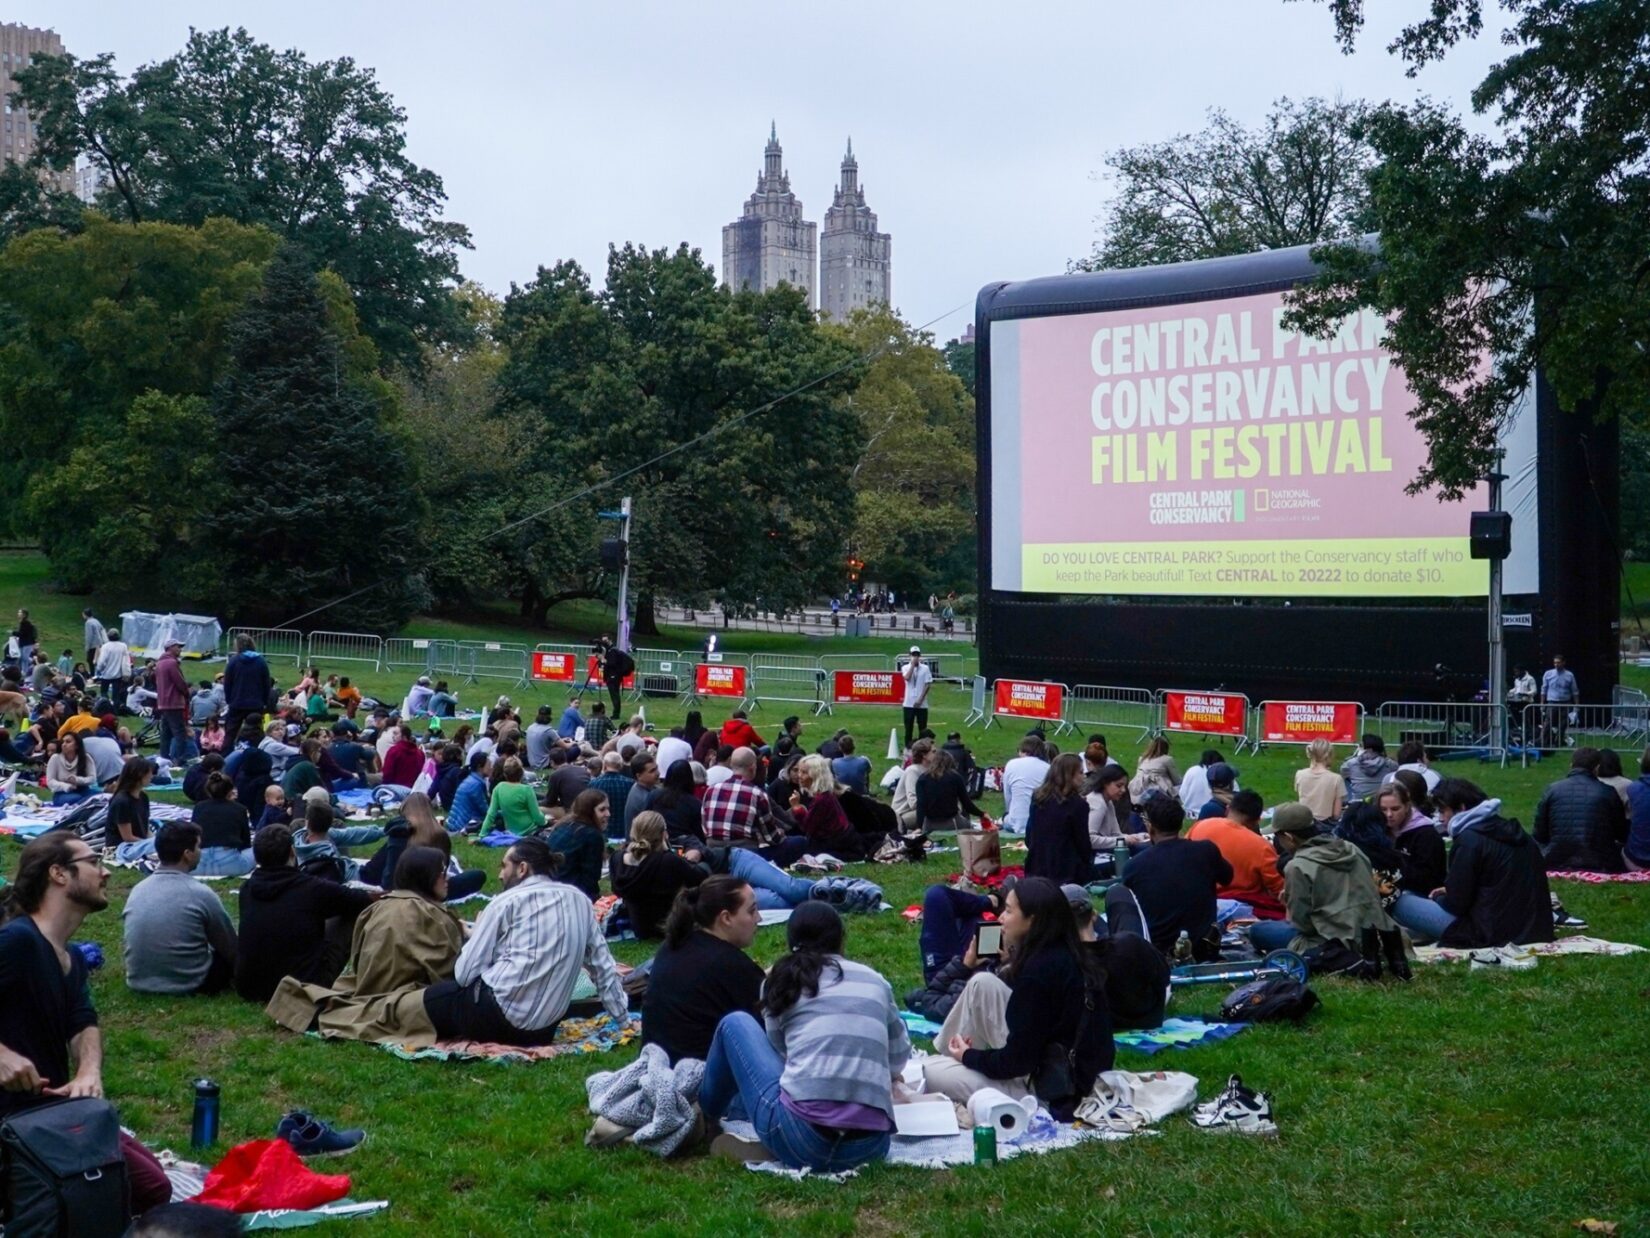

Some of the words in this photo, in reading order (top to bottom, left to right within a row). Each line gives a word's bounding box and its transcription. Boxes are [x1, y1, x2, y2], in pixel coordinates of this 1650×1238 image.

[1091, 310, 1261, 376] CENTRAL
[1091, 355, 1391, 430] CONSERVANCY
[1092, 430, 1177, 484] FILM
[1191, 417, 1392, 480] FESTIVAL
[1149, 492, 1199, 508] CENTRAL
[1201, 490, 1232, 506] PARK
[1271, 489, 1310, 499] NATIONAL
[1270, 498, 1321, 509] GEOGRAPHIC
[1150, 507, 1232, 524] CONSERVANCY
[1043, 552, 1059, 564] DO
[1062, 552, 1086, 564] YOU
[1089, 551, 1119, 564] LOVE
[1123, 551, 1178, 564] CENTRAL
[1182, 551, 1222, 563] PARK?
[1226, 550, 1276, 566] Support
[1281, 550, 1300, 563] the
[1304, 550, 1391, 566] Conservancy
[1395, 548, 1427, 563] staff
[1433, 548, 1464, 562] who
[1056, 569, 1081, 583] keep
[1084, 569, 1101, 582] the
[1105, 569, 1129, 582] Park
[1132, 569, 1184, 582] beautiful!
[1188, 569, 1212, 582] Text
[1216, 569, 1278, 582] CENTRAL
[1282, 570, 1295, 582] to
[1299, 569, 1341, 582] 20222
[1346, 569, 1359, 582] to
[1364, 568, 1412, 582] donate
[1416, 568, 1445, 583] $10.
[1011, 683, 1032, 692] CENTRAL
[1033, 685, 1046, 694] PARK
[1011, 691, 1046, 701] CONSERVANCY
[1184, 696, 1208, 705] CENTRAL
[1209, 697, 1225, 706] PARK
[1010, 698, 1022, 707] FILM
[1023, 700, 1045, 709] FESTIVAL
[1184, 704, 1224, 714] CONSERVANCY
[1286, 705, 1315, 714] CENTRAL
[1316, 706, 1335, 715] PARK
[1184, 712, 1198, 721] FILM
[1198, 713, 1224, 723] FESTIVAL
[1286, 714, 1334, 722] CONSERVANCY
[1285, 722, 1301, 731] FILM
[1302, 723, 1334, 732] FESTIVAL
